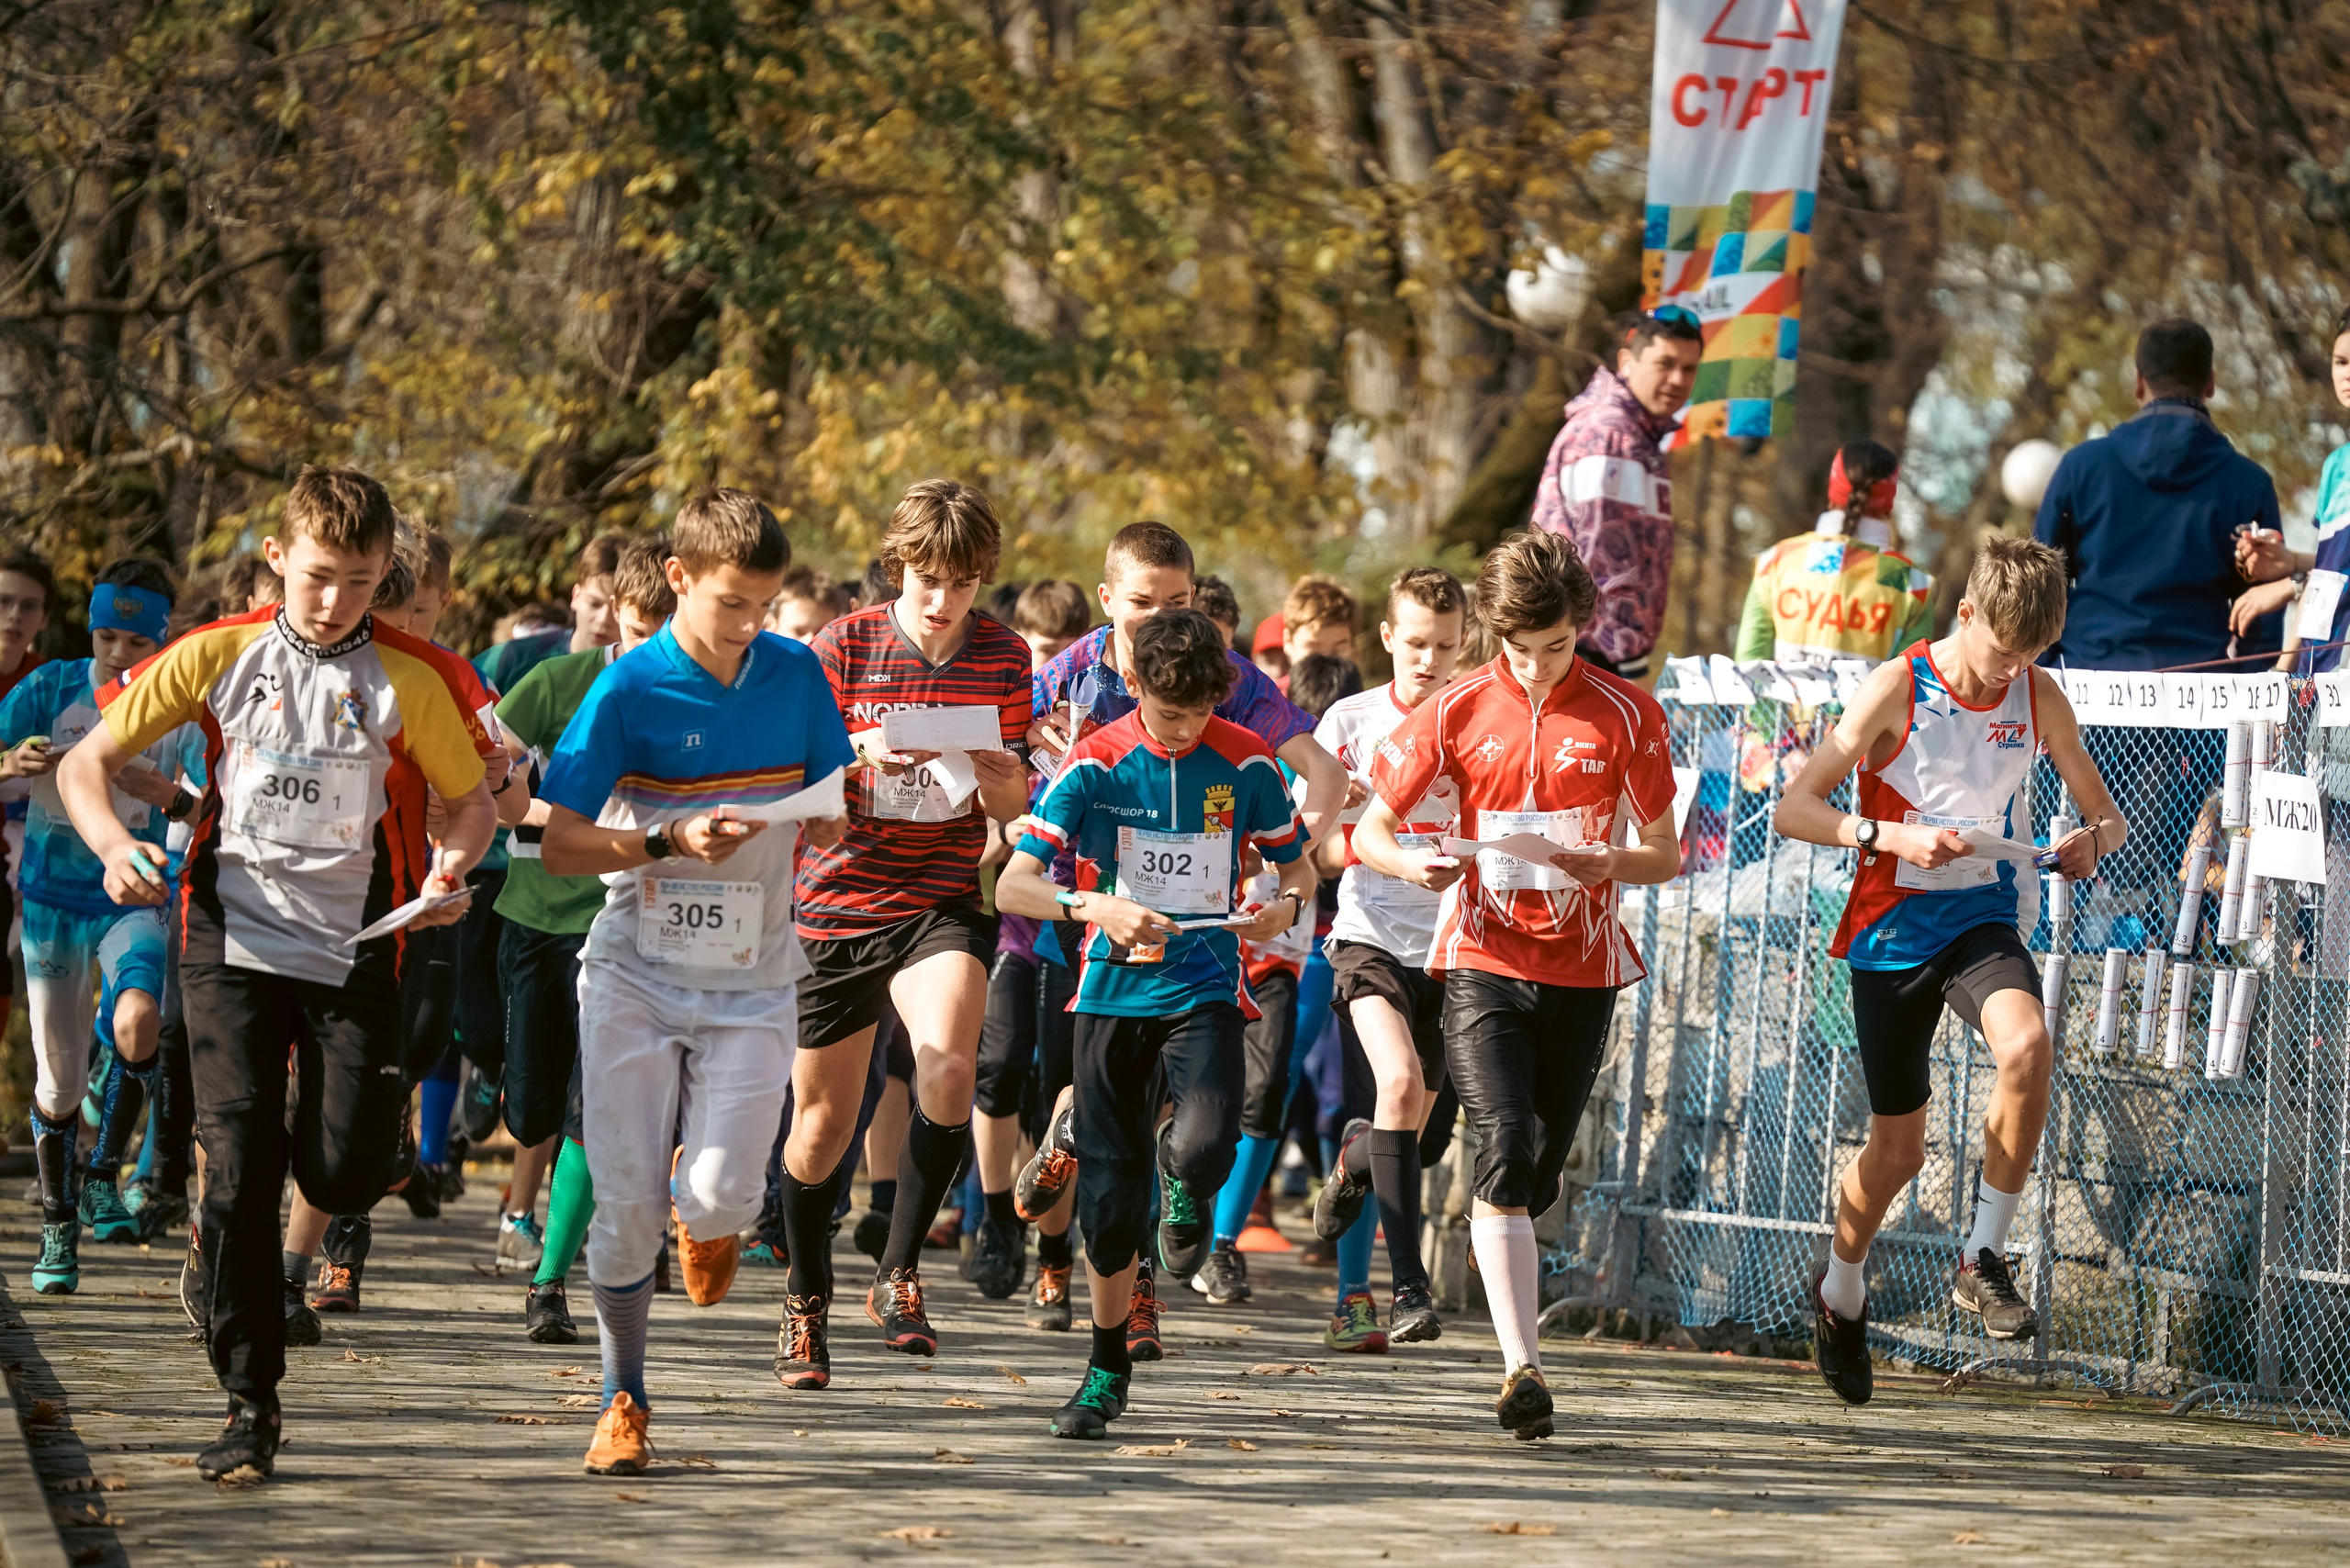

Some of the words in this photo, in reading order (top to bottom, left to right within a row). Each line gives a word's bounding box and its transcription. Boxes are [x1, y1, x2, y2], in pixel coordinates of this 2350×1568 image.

[1672, 67, 1827, 130] СТАРТ
[1777, 588, 1893, 634] СУДЬЯ
[2075, 683, 2088, 704] 11
[2109, 684, 2123, 706] 12
[2140, 684, 2156, 707] 13
[2177, 686, 2195, 709] 14
[2211, 686, 2228, 709] 15
[2266, 682, 2280, 708] 17
[2326, 684, 2342, 707] 31
[1998, 742, 2025, 750] Стрелка
[1580, 758, 1606, 774] TAR
[261, 774, 320, 804] 306
[893, 788, 926, 799] МЖ14
[252, 797, 290, 813] МЖ14
[332, 794, 341, 812] 1
[1147, 810, 1158, 819] 18
[1526, 814, 1547, 823] РОССИИ
[1921, 815, 1957, 826] ПЕРВЕНСТВО
[1957, 818, 1978, 826] РОССИИ
[2264, 797, 2317, 834] МЖ20
[1142, 850, 1192, 876] 302
[1203, 865, 1209, 879] 1
[1135, 871, 1167, 886] МЖ14
[667, 902, 723, 929] 305
[734, 917, 741, 934] 1
[659, 926, 697, 939] МЖ14
